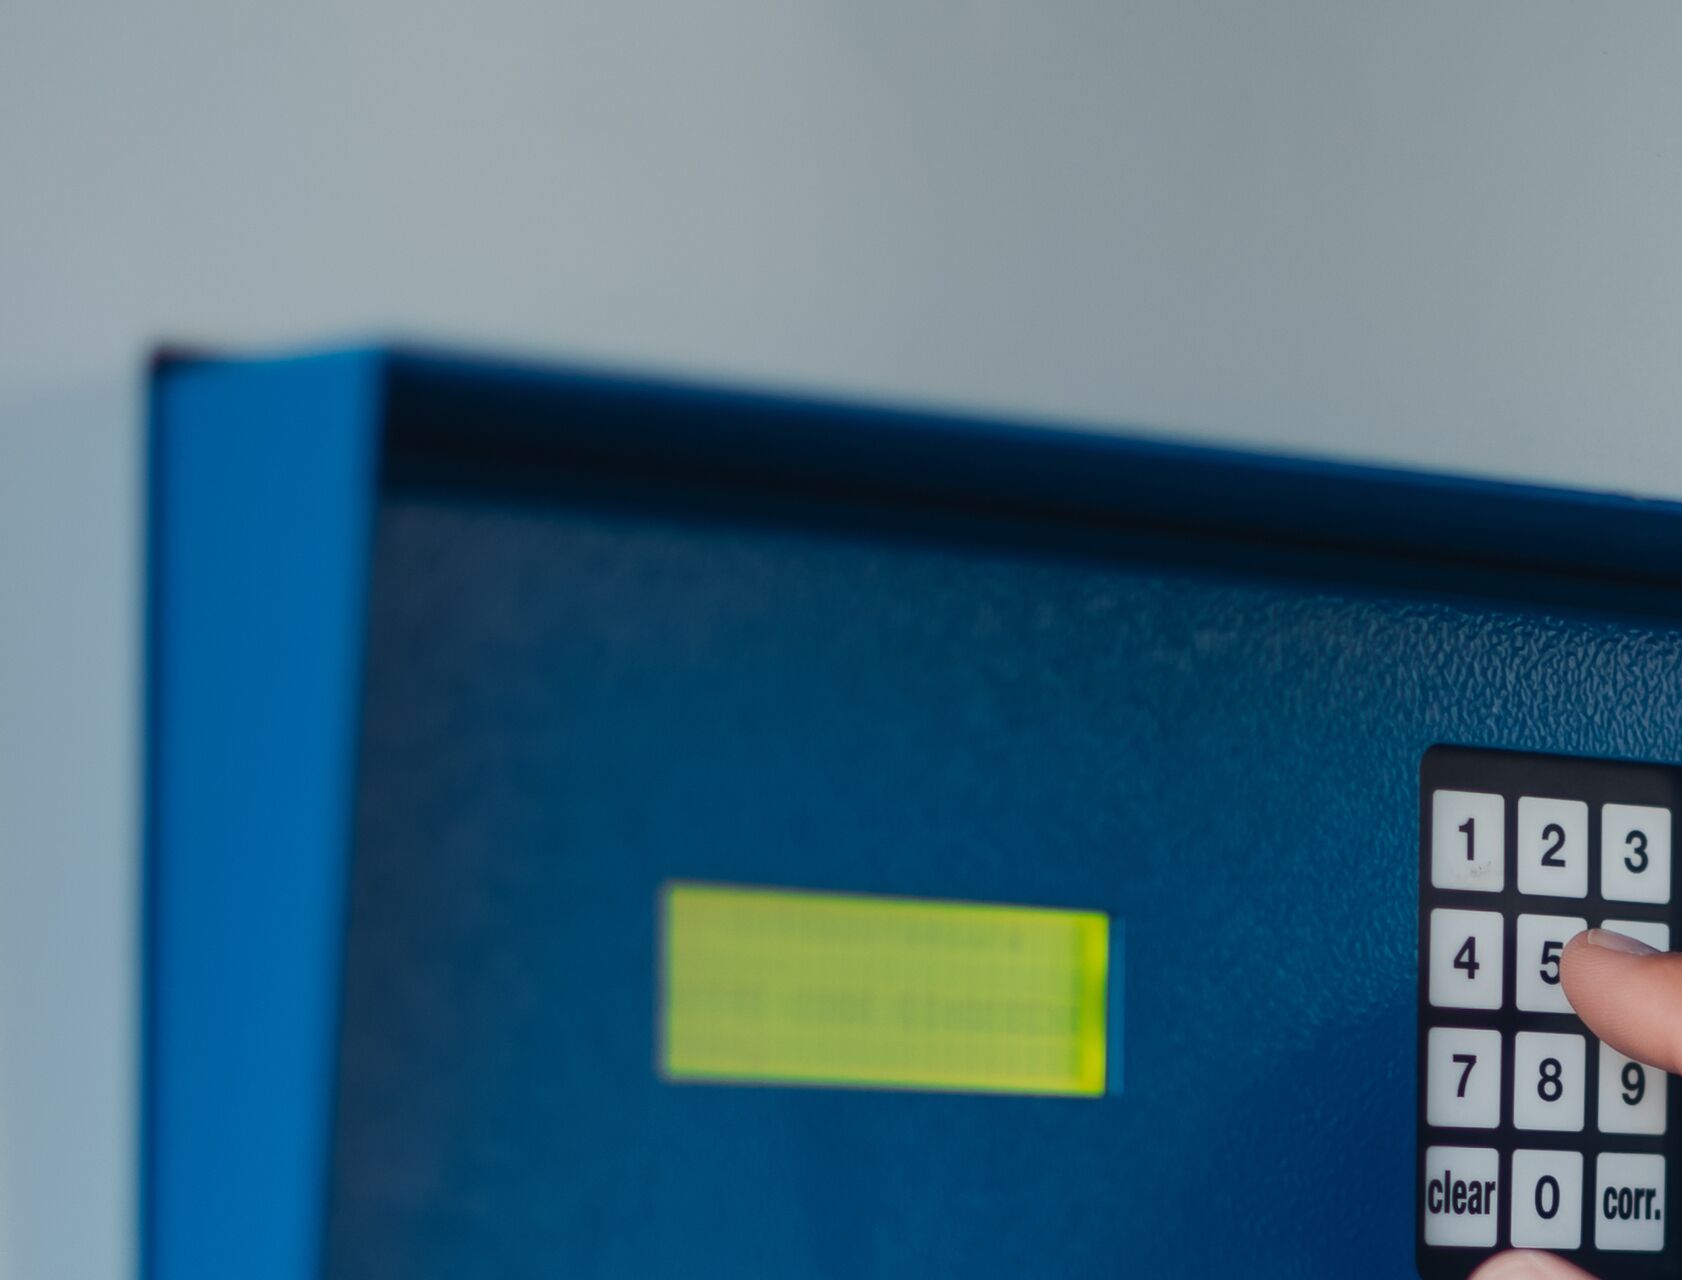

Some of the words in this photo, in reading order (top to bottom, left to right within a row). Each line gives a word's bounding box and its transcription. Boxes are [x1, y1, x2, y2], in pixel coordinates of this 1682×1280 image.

[1457, 817, 1476, 861] 1
[1540, 823, 1567, 868] 2
[1623, 829, 1650, 874] 3
[1453, 935, 1480, 980] 4
[1538, 940, 1562, 986] 5
[1452, 1053, 1478, 1098] 7
[1536, 1057, 1564, 1102] 8
[1620, 1062, 1646, 1106] 9
[1427, 1169, 1496, 1215] clear
[1534, 1174, 1561, 1220] 0
[1602, 1186, 1662, 1221] corr.
